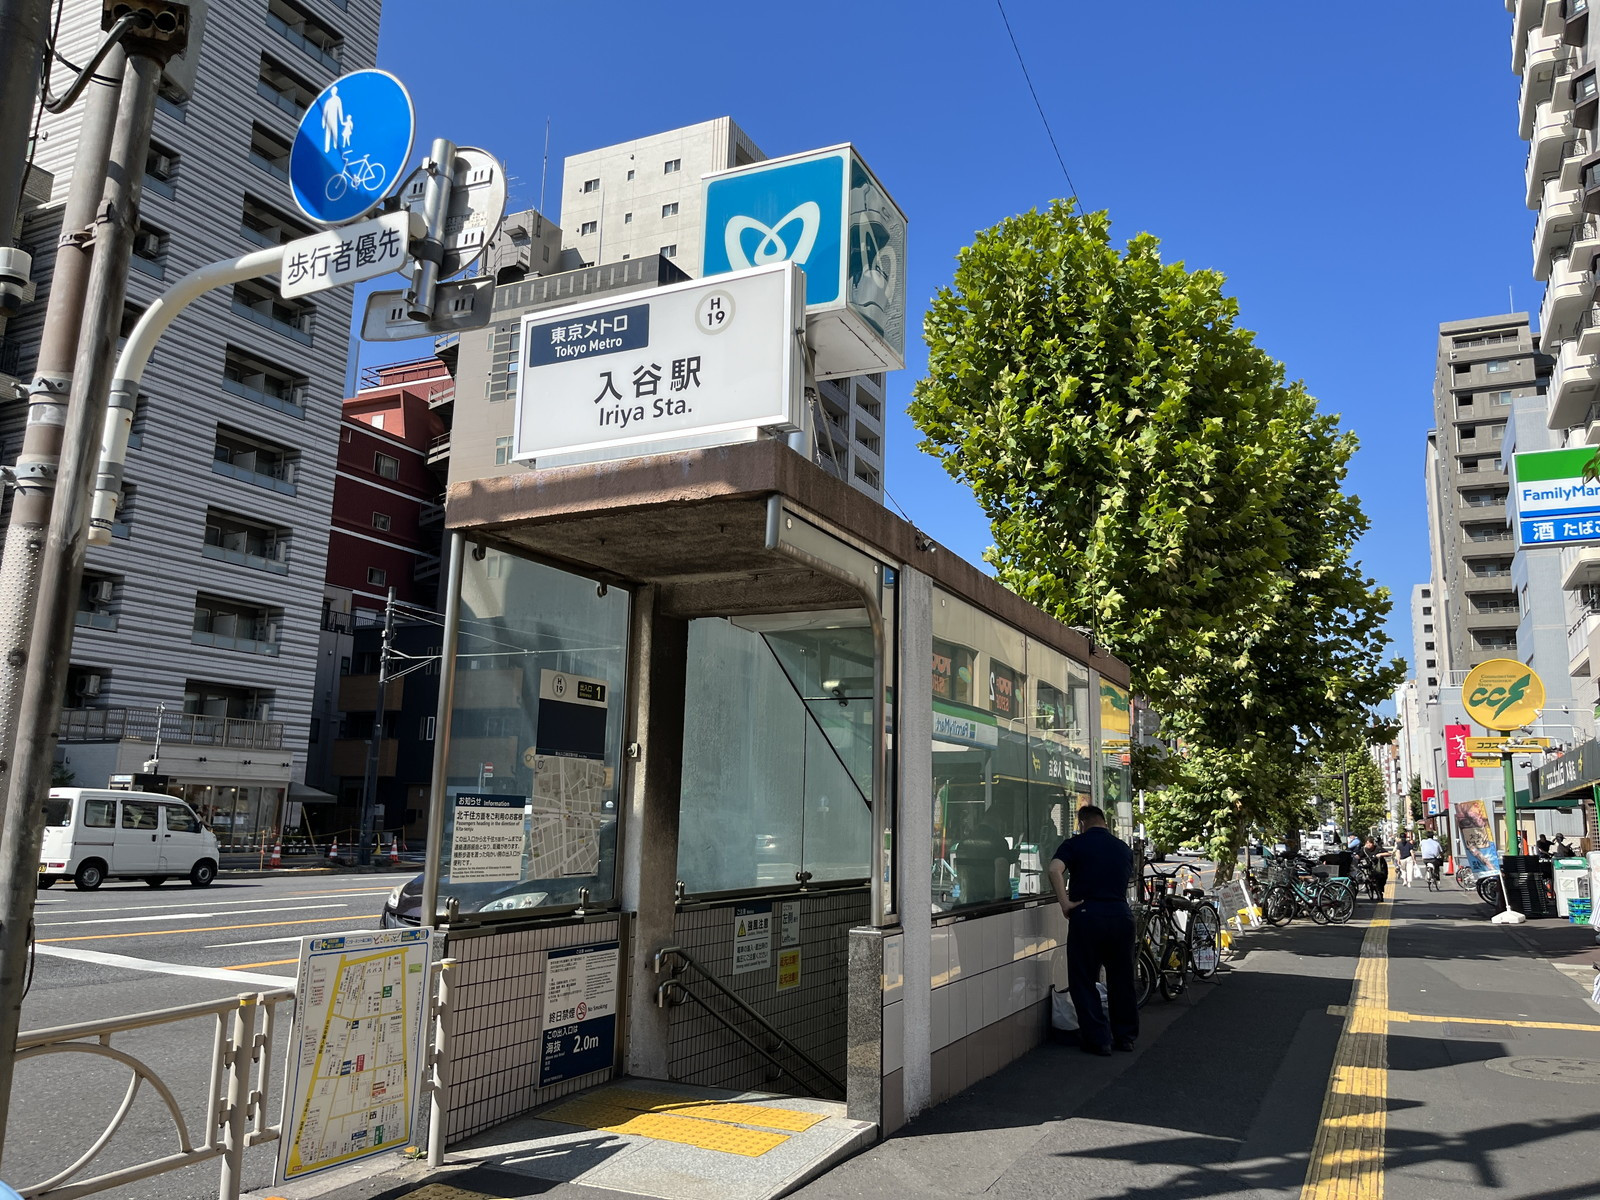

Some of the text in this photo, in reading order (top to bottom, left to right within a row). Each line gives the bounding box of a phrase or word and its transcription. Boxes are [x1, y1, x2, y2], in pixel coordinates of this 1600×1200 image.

[288, 227, 400, 286] 歩行者優先
[710, 298, 721, 310] H
[707, 311, 725, 326] 19
[551, 315, 628, 345] 東京メトロ
[555, 336, 622, 358] Tokyo Metro
[594, 356, 701, 404] 入谷駅
[600, 398, 692, 428] Iriya Sta.
[1523, 486, 1600, 501] FamilyMar
[1532, 522, 1554, 540] 酒
[556, 685, 563, 693] 19
[596, 686, 601, 699] 1
[459, 797, 481, 805] お知らせ
[457, 811, 522, 820] 北千住方面をご利用のお客様
[549, 1008, 575, 1023] 終日禁煙
[547, 1025, 578, 1040] この出入口は
[546, 1035, 599, 1054] 海抜 2.0m
